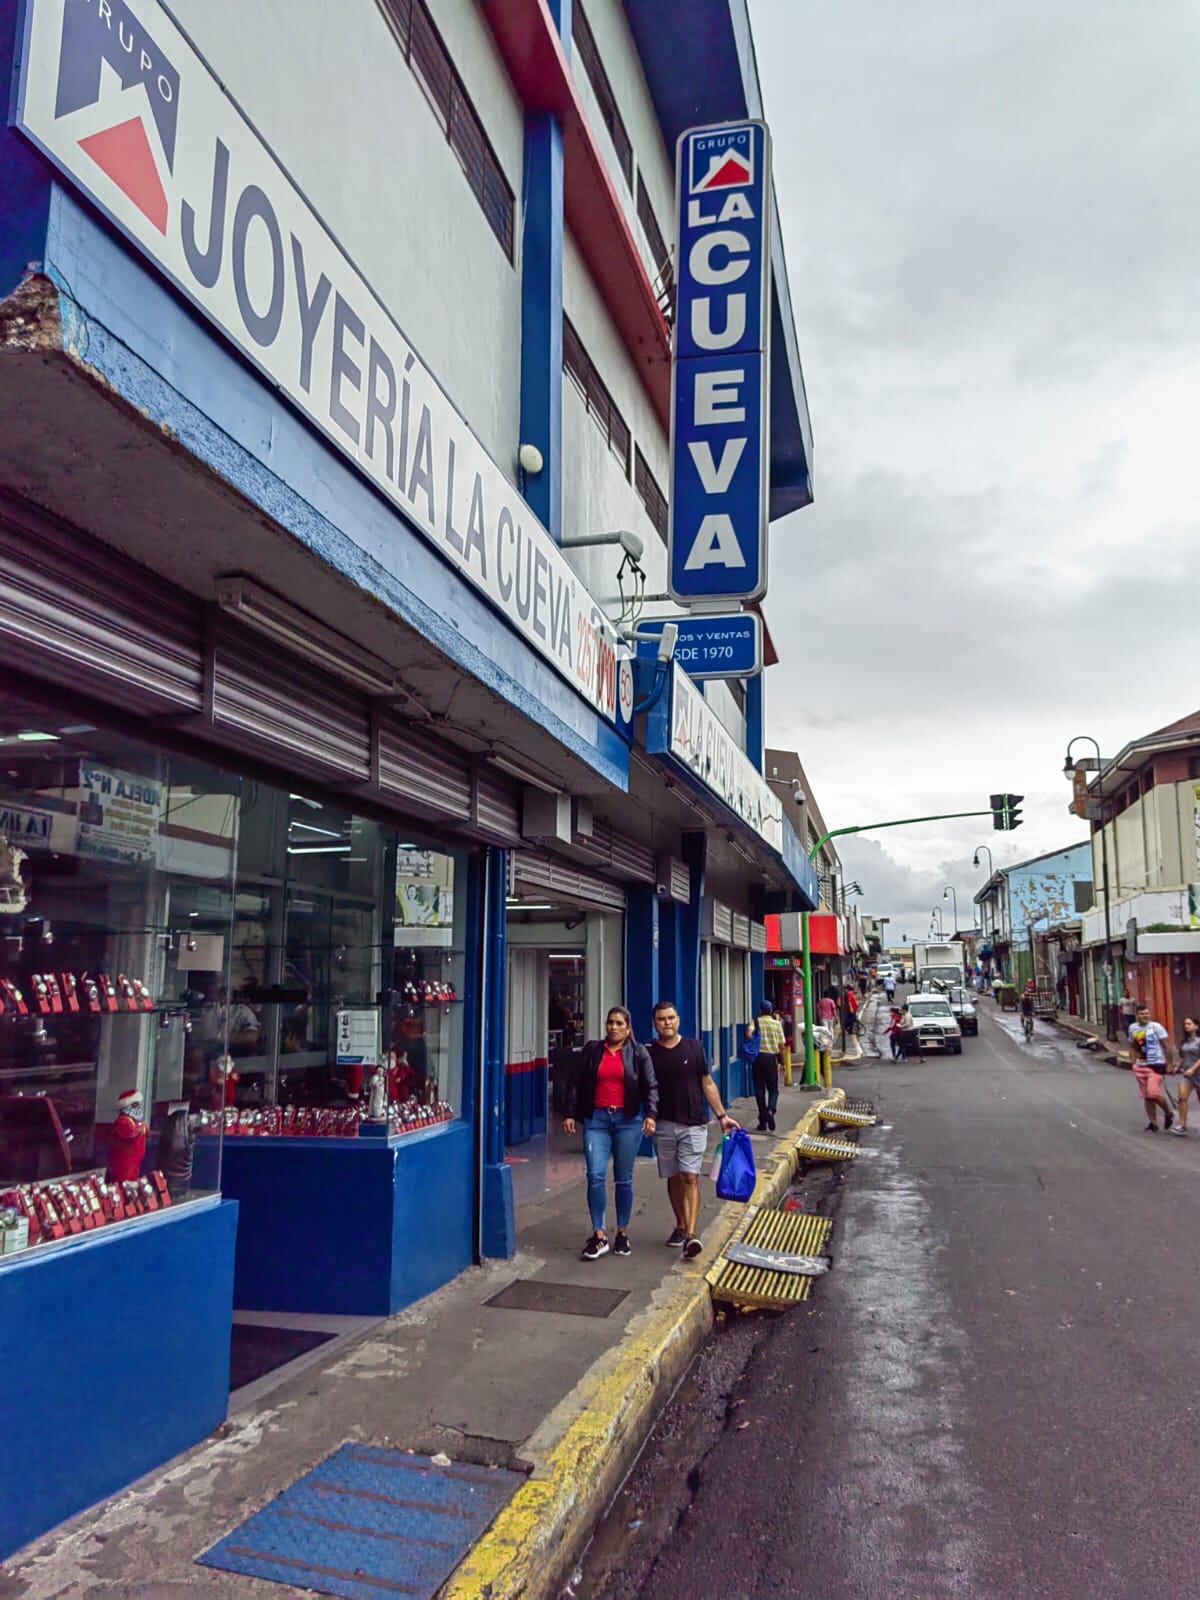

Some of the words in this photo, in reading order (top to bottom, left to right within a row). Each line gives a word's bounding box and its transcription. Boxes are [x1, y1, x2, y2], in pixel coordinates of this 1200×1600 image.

[86, 0, 173, 102] RUPO
[697, 134, 747, 151] GRUPO
[687, 192, 755, 228] LA
[180, 136, 435, 526] JOYERÍA
[444, 437, 488, 581] LA
[496, 506, 574, 668] CUEVA
[684, 230, 751, 570] CUEVA
[696, 633, 704, 641] Y
[705, 630, 751, 641] VENTAS
[702, 646, 734, 659] 1970
